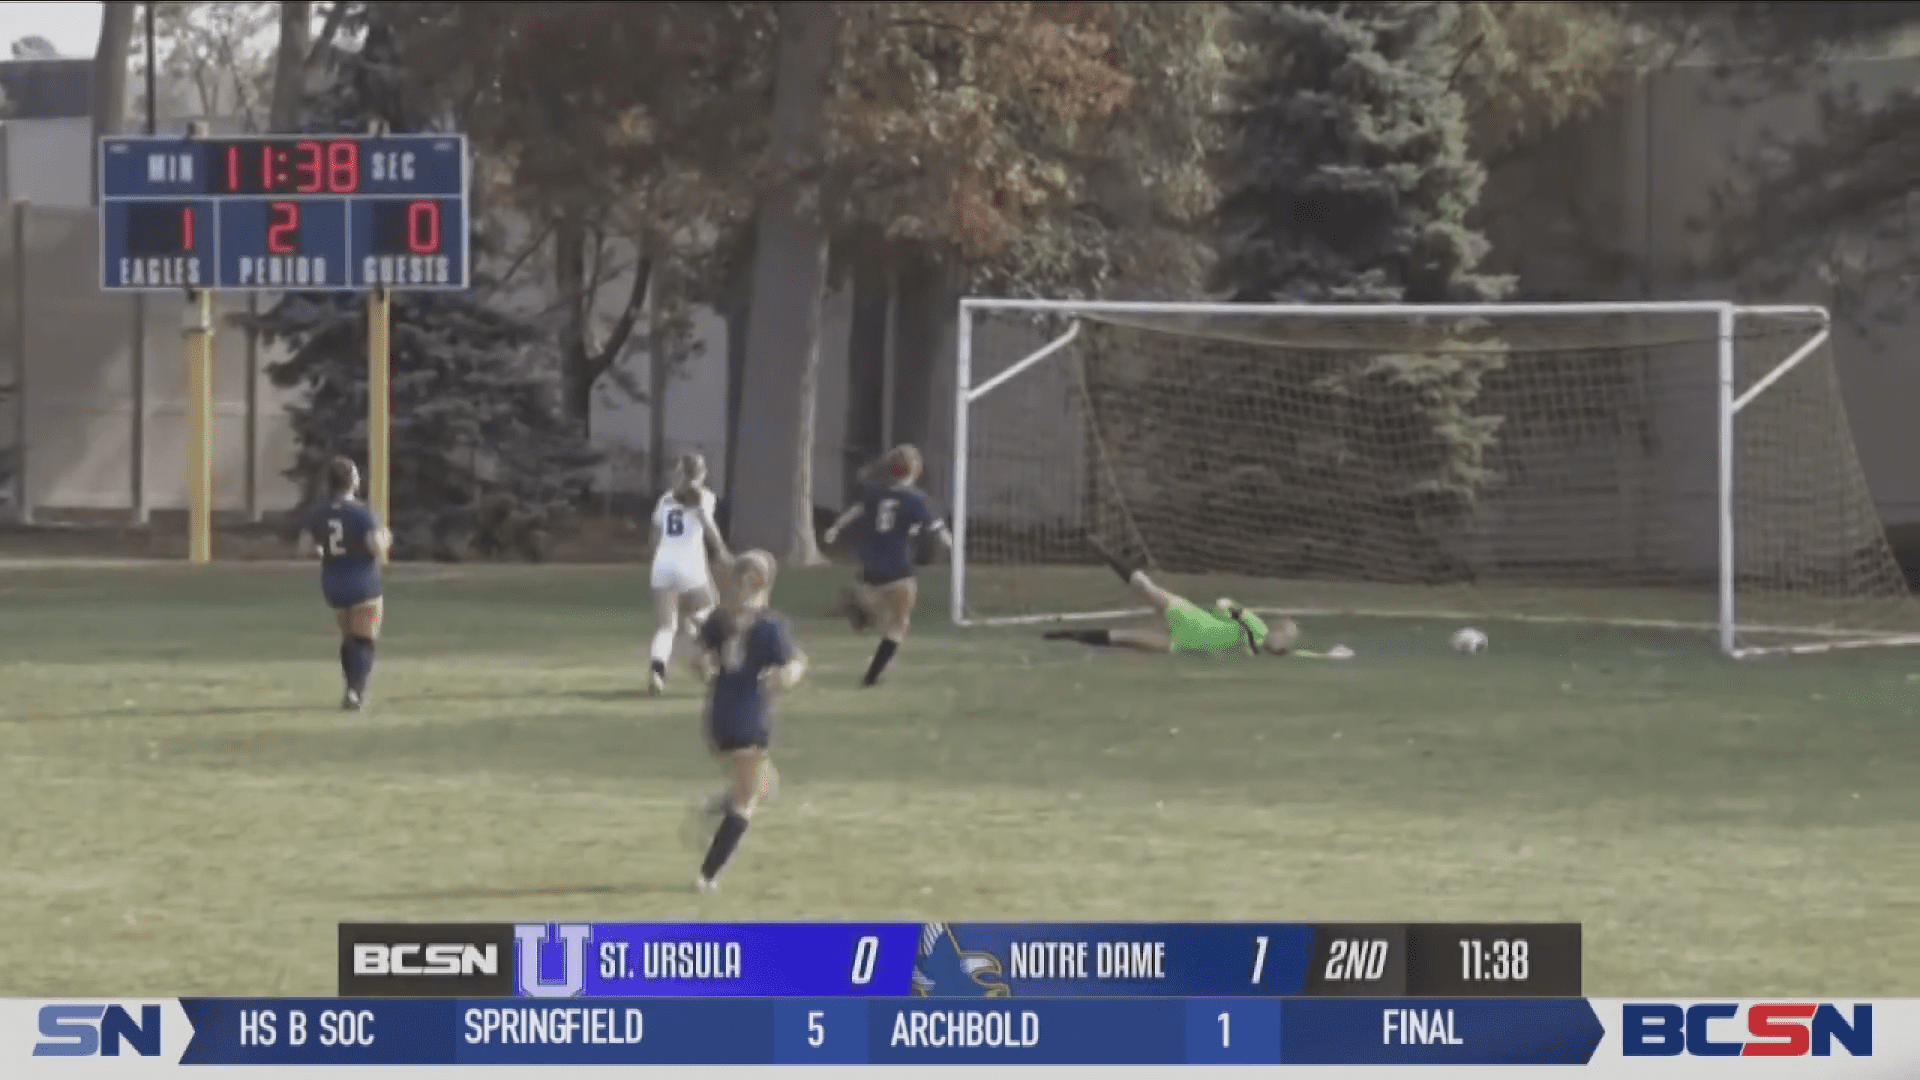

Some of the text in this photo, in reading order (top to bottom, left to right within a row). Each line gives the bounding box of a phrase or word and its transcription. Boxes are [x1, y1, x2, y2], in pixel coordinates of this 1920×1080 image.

[226, 139, 359, 194] 11:38
[371, 151, 415, 181] SEC
[181, 205, 195, 251] 1
[266, 200, 299, 255] 2
[407, 199, 441, 255] 0
[119, 256, 200, 285] EAGLES
[238, 255, 327, 284] PERIOD
[362, 256, 449, 284] GUESTS
[328, 519, 346, 555] 2
[667, 509, 684, 536] 6
